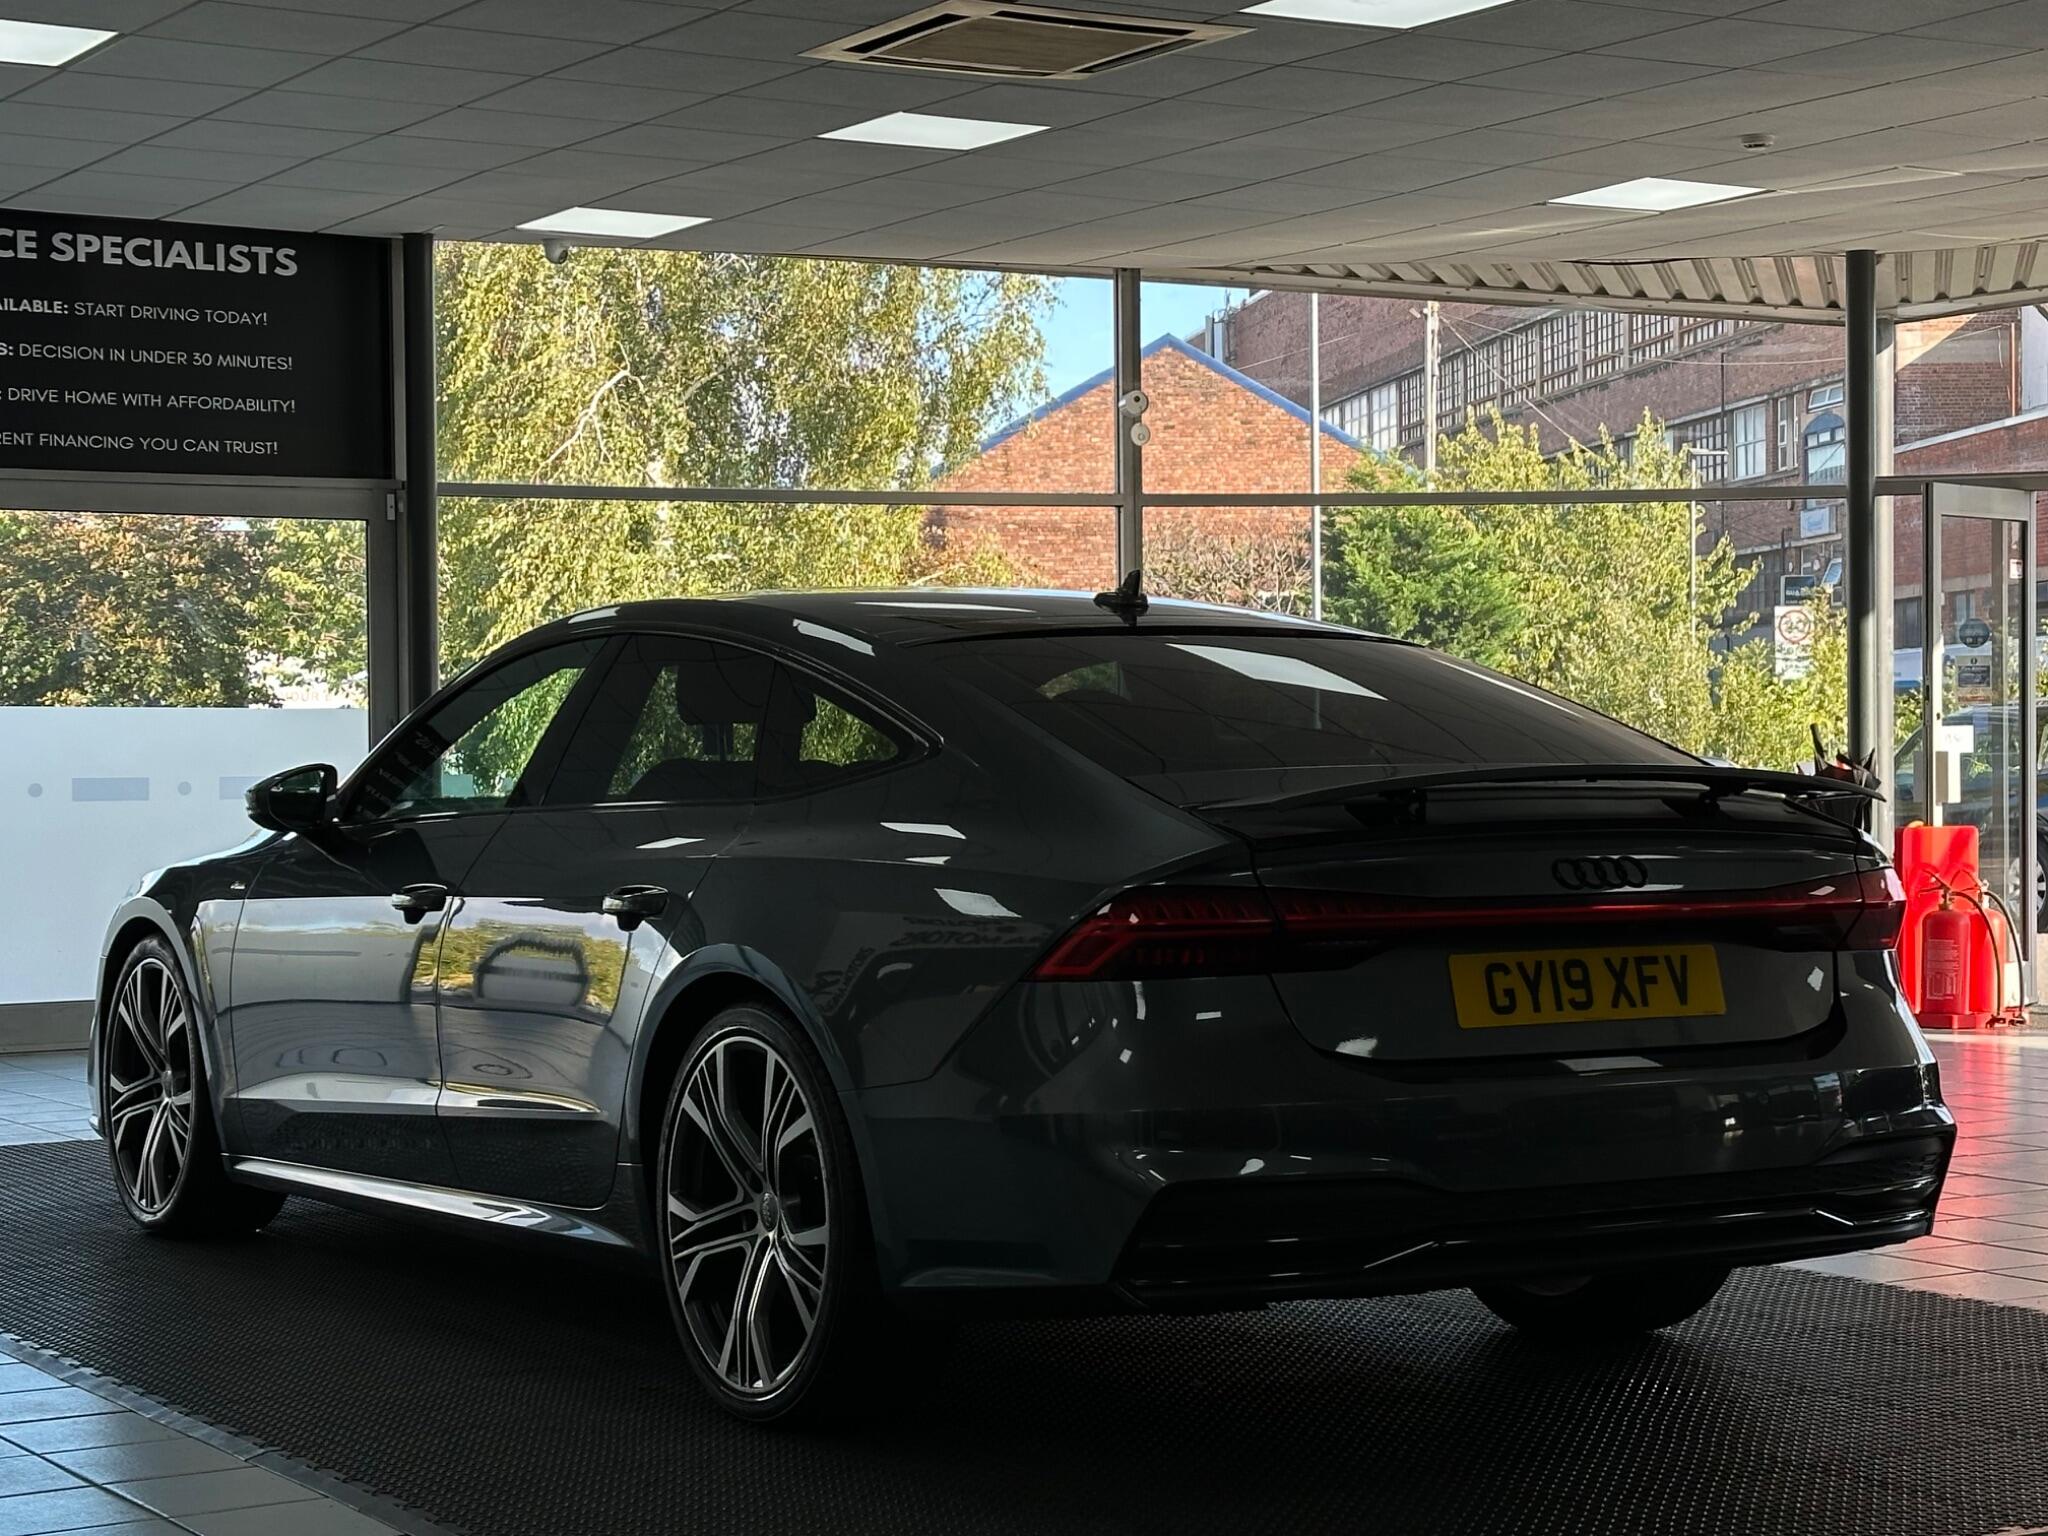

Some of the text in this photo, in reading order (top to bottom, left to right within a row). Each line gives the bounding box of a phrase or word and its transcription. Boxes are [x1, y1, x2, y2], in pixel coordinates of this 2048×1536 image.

[50, 231, 299, 276] SPECIALISTS
[74, 302, 126, 318] START
[130, 305, 200, 322] DRIVING
[204, 309, 268, 326] TODAY!
[19, 343, 104, 361] DECISION
[109, 348, 125, 362] IN
[130, 349, 188, 365] UNDER
[192, 352, 213, 367] 30
[216, 354, 293, 371] MINUTES!
[7, 387, 296, 413] DRIVE HOME WITH AFFORDABILITY!
[0, 431, 278, 455] ENT FINANCING YOU CAN TRUST!
[1485, 955, 1688, 1015] GY19 XFV
